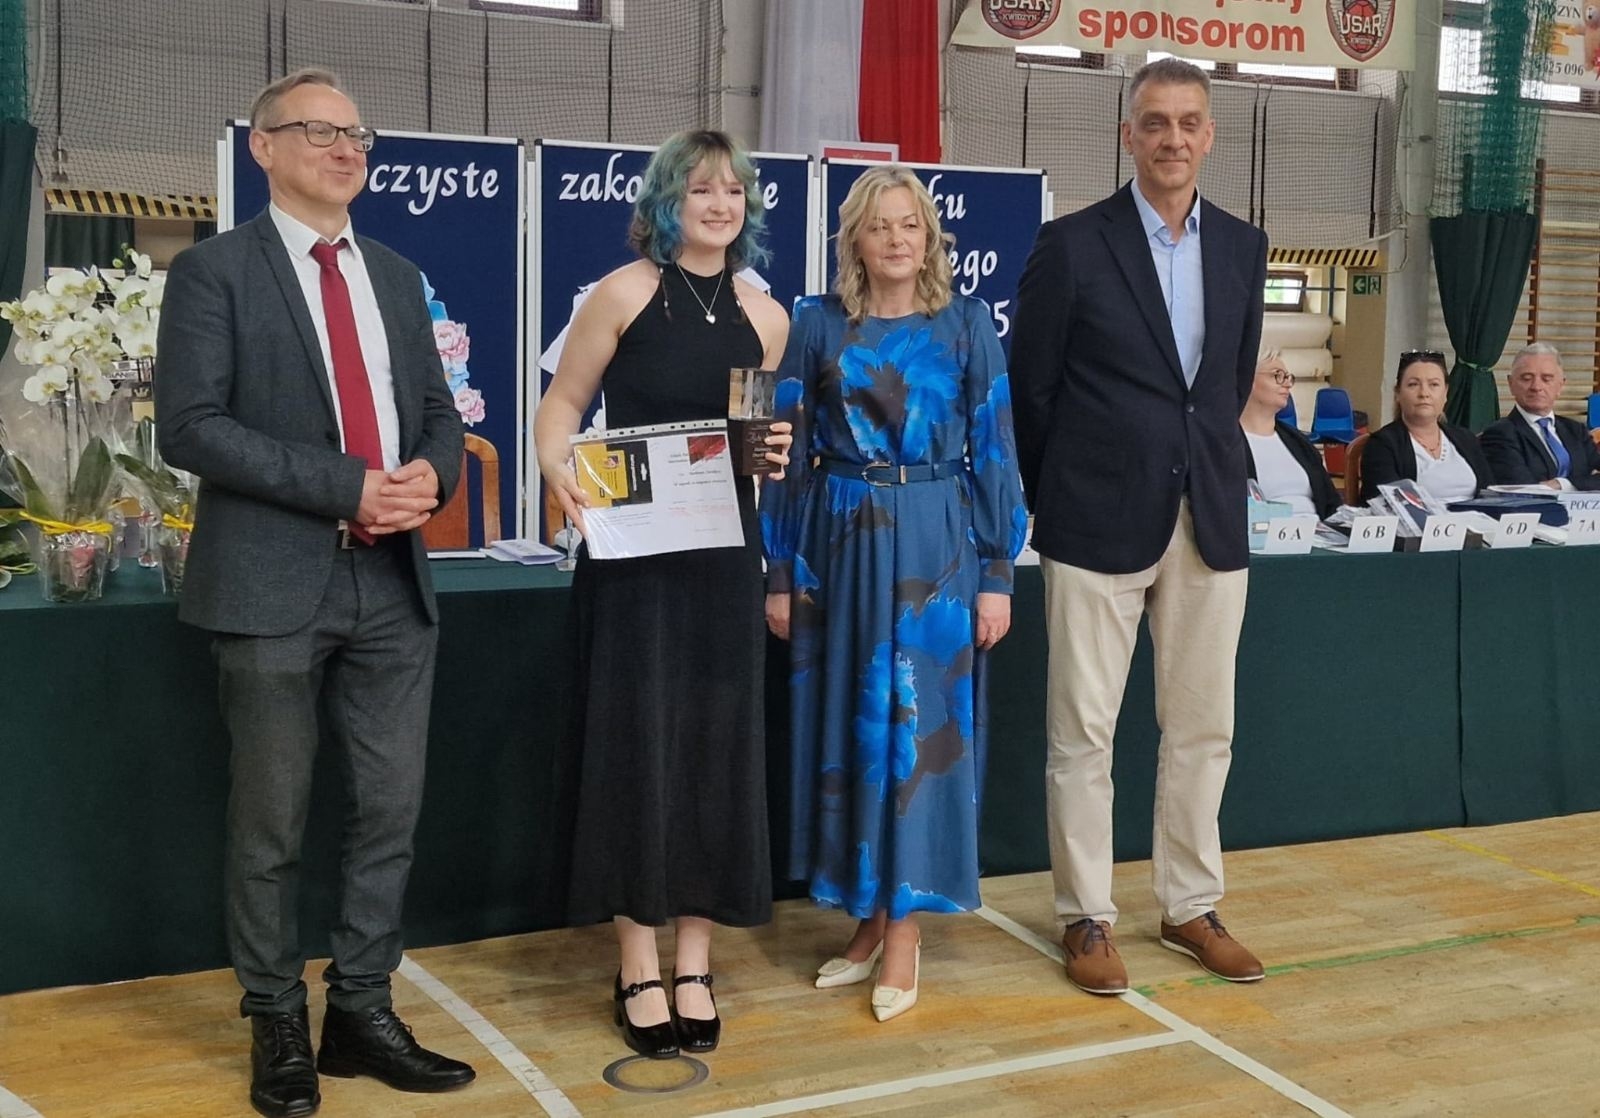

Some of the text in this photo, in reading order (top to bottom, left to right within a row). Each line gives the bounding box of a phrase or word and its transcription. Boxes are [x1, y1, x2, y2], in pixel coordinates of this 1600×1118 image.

[1079, 9, 1304, 52] sponsorom
[1338, 11, 1383, 37] USAR
[1564, 63, 1584, 76] 096
[364, 162, 499, 216] czyste
[1362, 525, 1386, 540] 6 B
[1432, 523, 1457, 538] 6 C
[1505, 521, 1528, 535] 6 D
[1578, 519, 1595, 532] 7 A
[1278, 526, 1302, 541] 6 A
